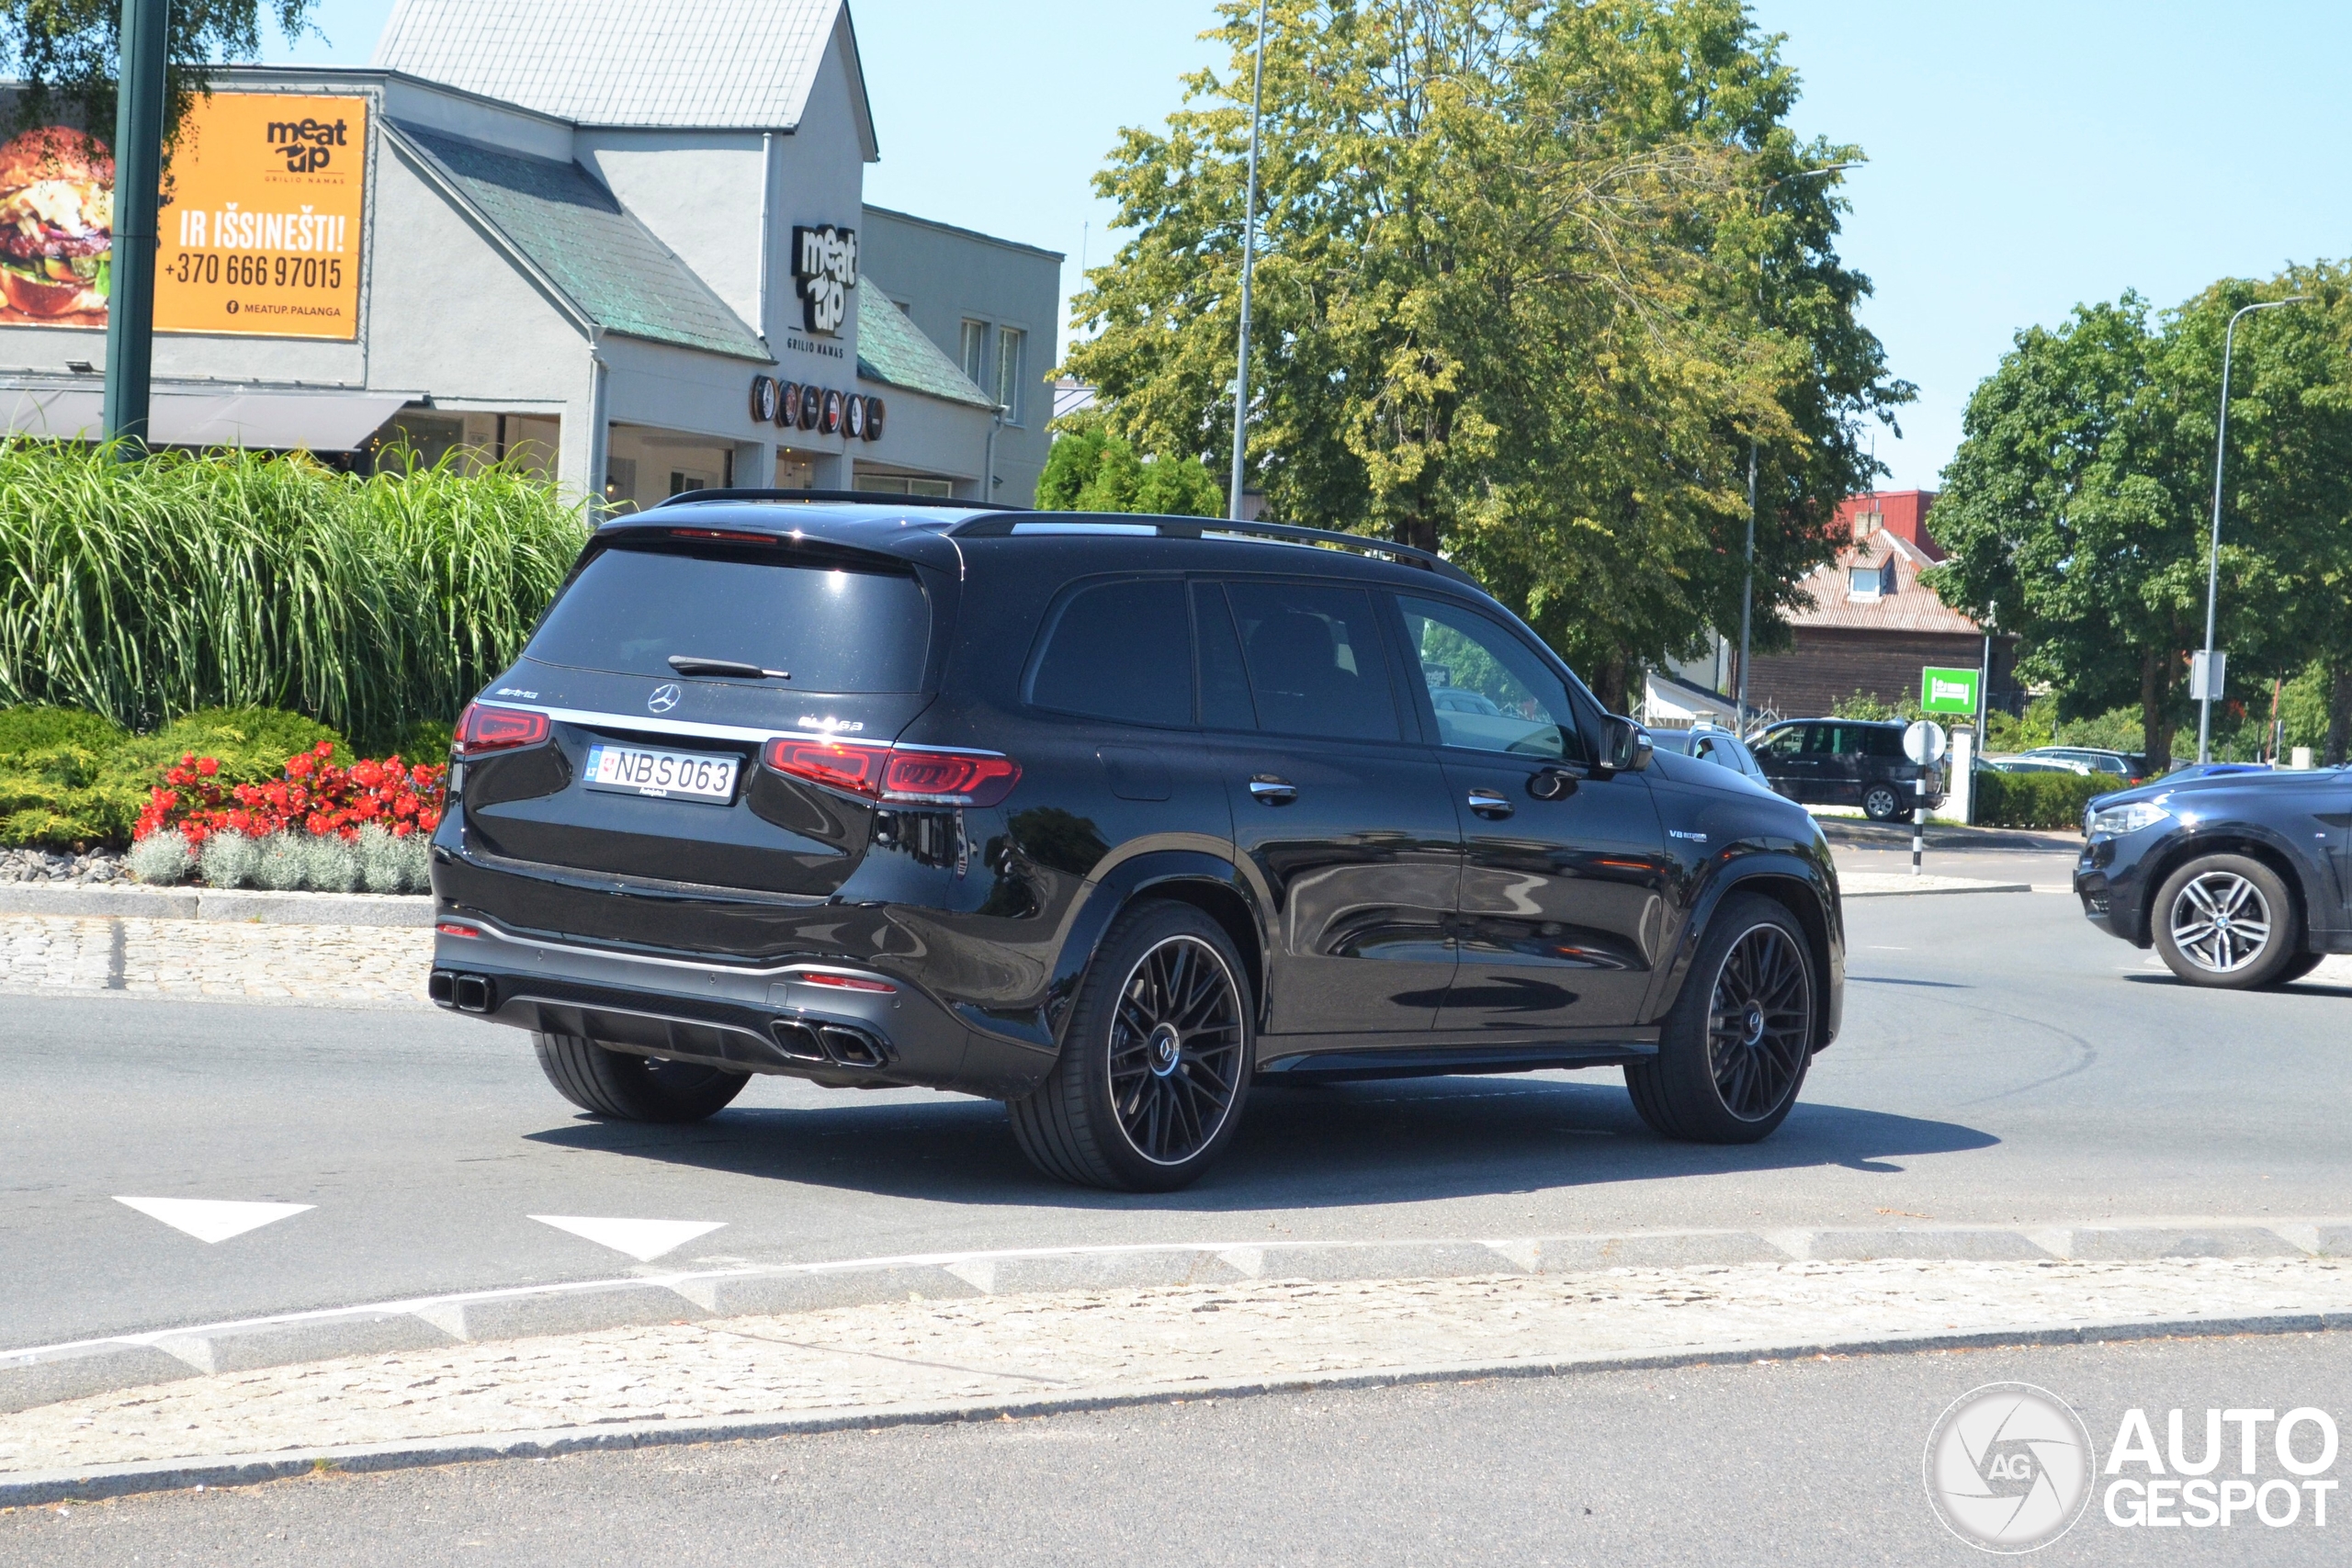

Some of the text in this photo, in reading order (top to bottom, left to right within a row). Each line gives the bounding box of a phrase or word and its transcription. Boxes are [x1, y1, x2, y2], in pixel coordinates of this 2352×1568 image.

[266, 118, 346, 146] meat
[279, 143, 330, 173] up
[180, 202, 345, 253] IR IŠSINEŠTI!
[165, 253, 342, 289] +370 666 97015
[801, 228, 856, 286] meat
[809, 274, 845, 332] up
[787, 337, 843, 359] GRILIO NAMAS
[586, 767, 597, 777] LT
